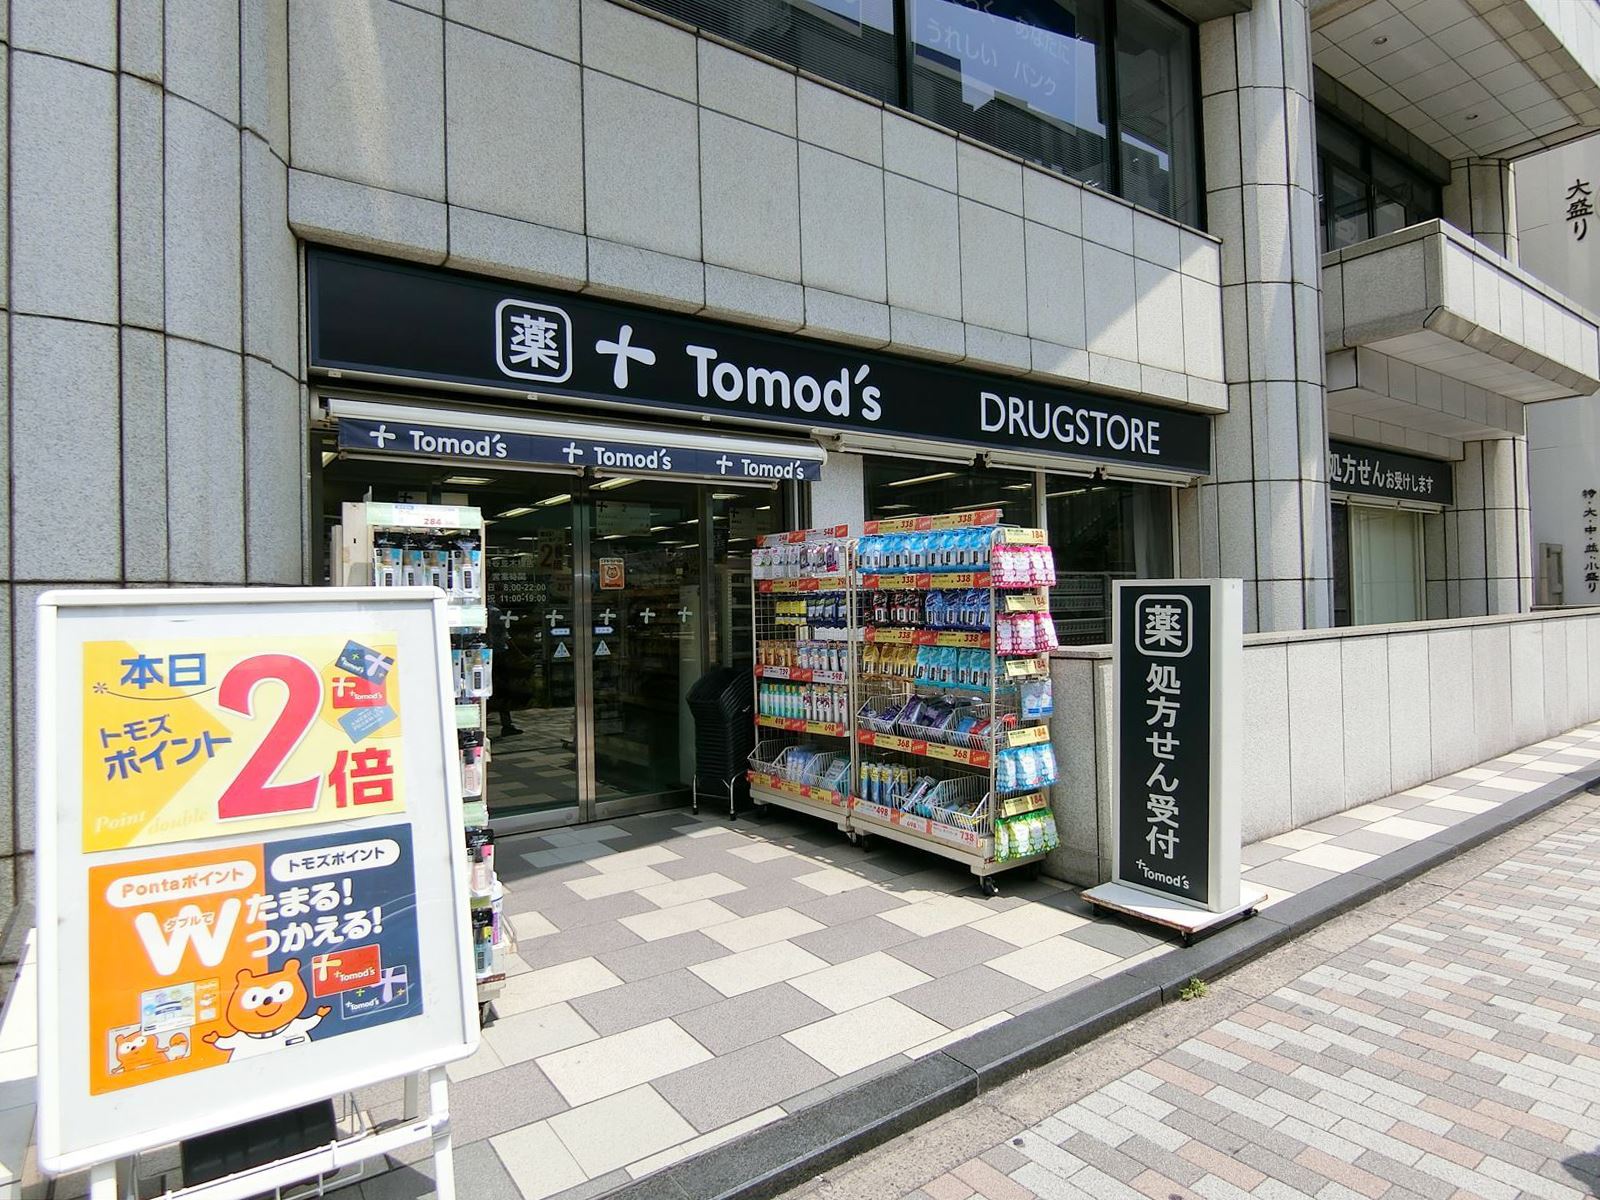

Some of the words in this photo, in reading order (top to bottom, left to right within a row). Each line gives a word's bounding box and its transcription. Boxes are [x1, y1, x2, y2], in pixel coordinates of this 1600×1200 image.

[927, 18, 997, 67] うれしい
[1565, 178, 1593, 241] 大盛り
[509, 313, 560, 371] 薬
[686, 344, 881, 421] Tomod's
[980, 391, 1160, 455] DRUGSTORE
[409, 430, 508, 459] Tomod's
[593, 447, 672, 472] Tomod's
[741, 458, 805, 480] Tomod's
[900, 520, 914, 528] 338
[959, 514, 972, 523] 338
[1031, 530, 1044, 539] 184
[902, 575, 914, 583] 338
[957, 574, 971, 583] 338
[1033, 596, 1046, 606] 184
[898, 631, 911, 639] 338
[1144, 604, 1182, 647] 薬
[964, 634, 979, 643] 338
[121, 653, 206, 690] 本日
[1033, 659, 1046, 670] 184
[832, 672, 843, 680] 598
[100, 714, 172, 749] トモズ
[1033, 727, 1047, 738] 184
[897, 739, 910, 748] 368
[104, 731, 233, 781] ポイント
[953, 749, 968, 759] 368
[1145, 663, 1181, 860] 処方せん受付
[876, 806, 889, 817] 498
[960, 831, 975, 842] 738
[288, 846, 385, 873] トモズポイント
[121, 867, 244, 898] Pontaポイント
[1142, 865, 1191, 889] Tomod's
[246, 877, 353, 925] たまる!
[135, 898, 242, 976] W
[246, 907, 383, 957] つかえる!
[340, 966, 376, 983] Tomod's
[350, 998, 379, 1011] Tomod's
